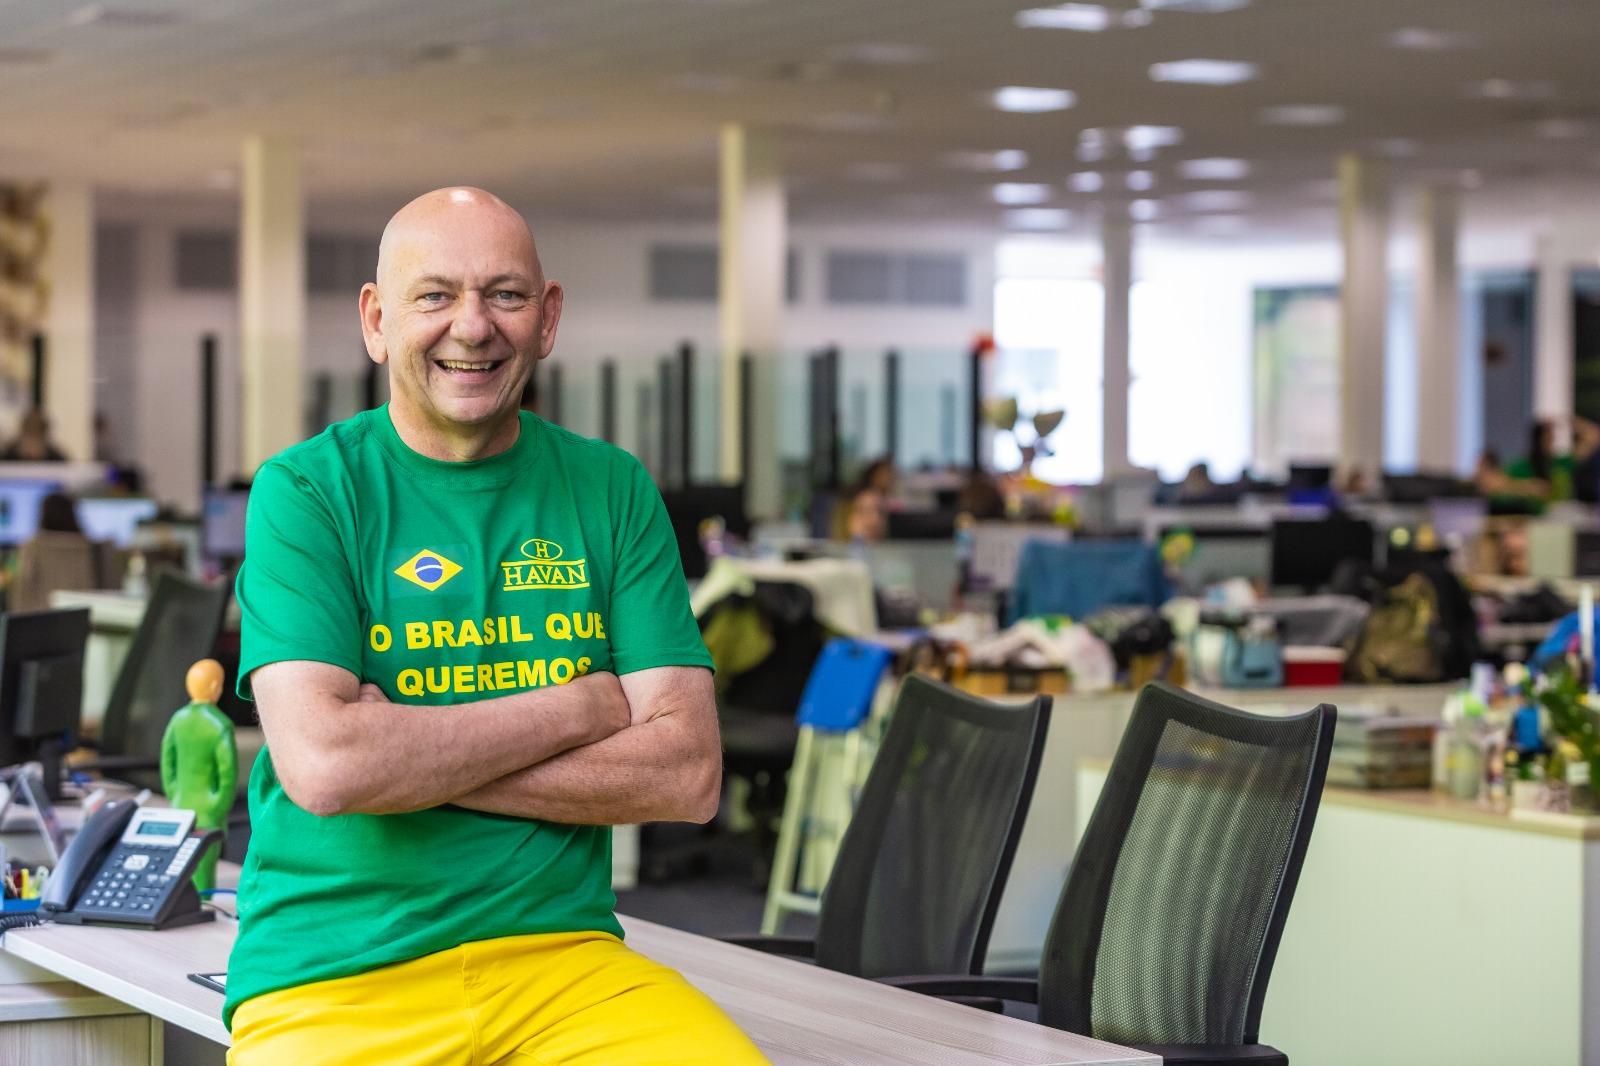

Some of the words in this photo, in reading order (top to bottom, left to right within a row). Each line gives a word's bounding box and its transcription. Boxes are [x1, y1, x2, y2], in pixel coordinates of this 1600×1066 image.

[534, 541, 550, 558] H
[502, 563, 587, 586] HAVAN
[369, 624, 393, 652] O
[405, 615, 533, 650] BRASIL
[545, 612, 606, 641] QUE
[396, 656, 592, 697] QUEREMOS
